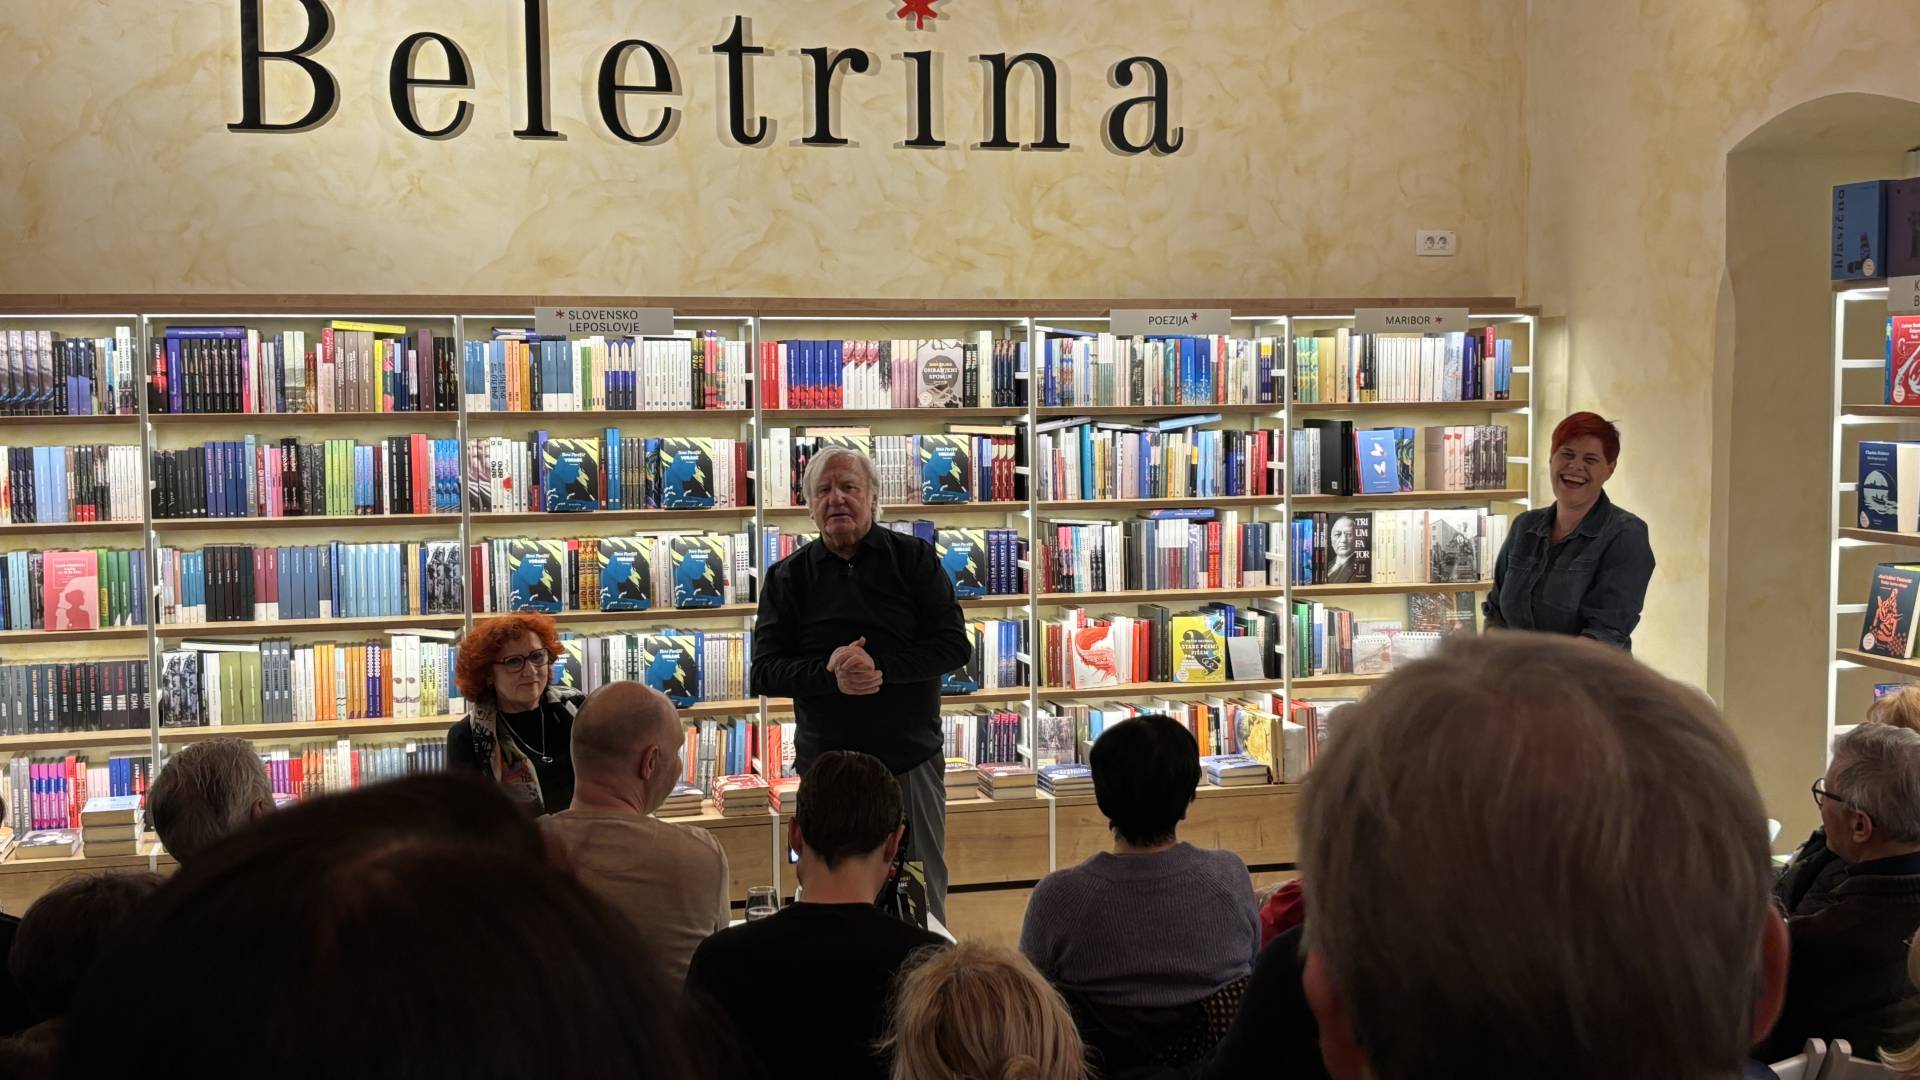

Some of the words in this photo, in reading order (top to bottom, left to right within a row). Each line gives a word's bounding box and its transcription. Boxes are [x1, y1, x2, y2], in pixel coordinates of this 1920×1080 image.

[227, 0, 1184, 154] Beletrina
[568, 310, 639, 321] SLOVENSKO
[1148, 315, 1189, 326] POEZIJA
[1385, 315, 1431, 326] MARIBOR
[568, 322, 641, 333] LEPOSLOVJE
